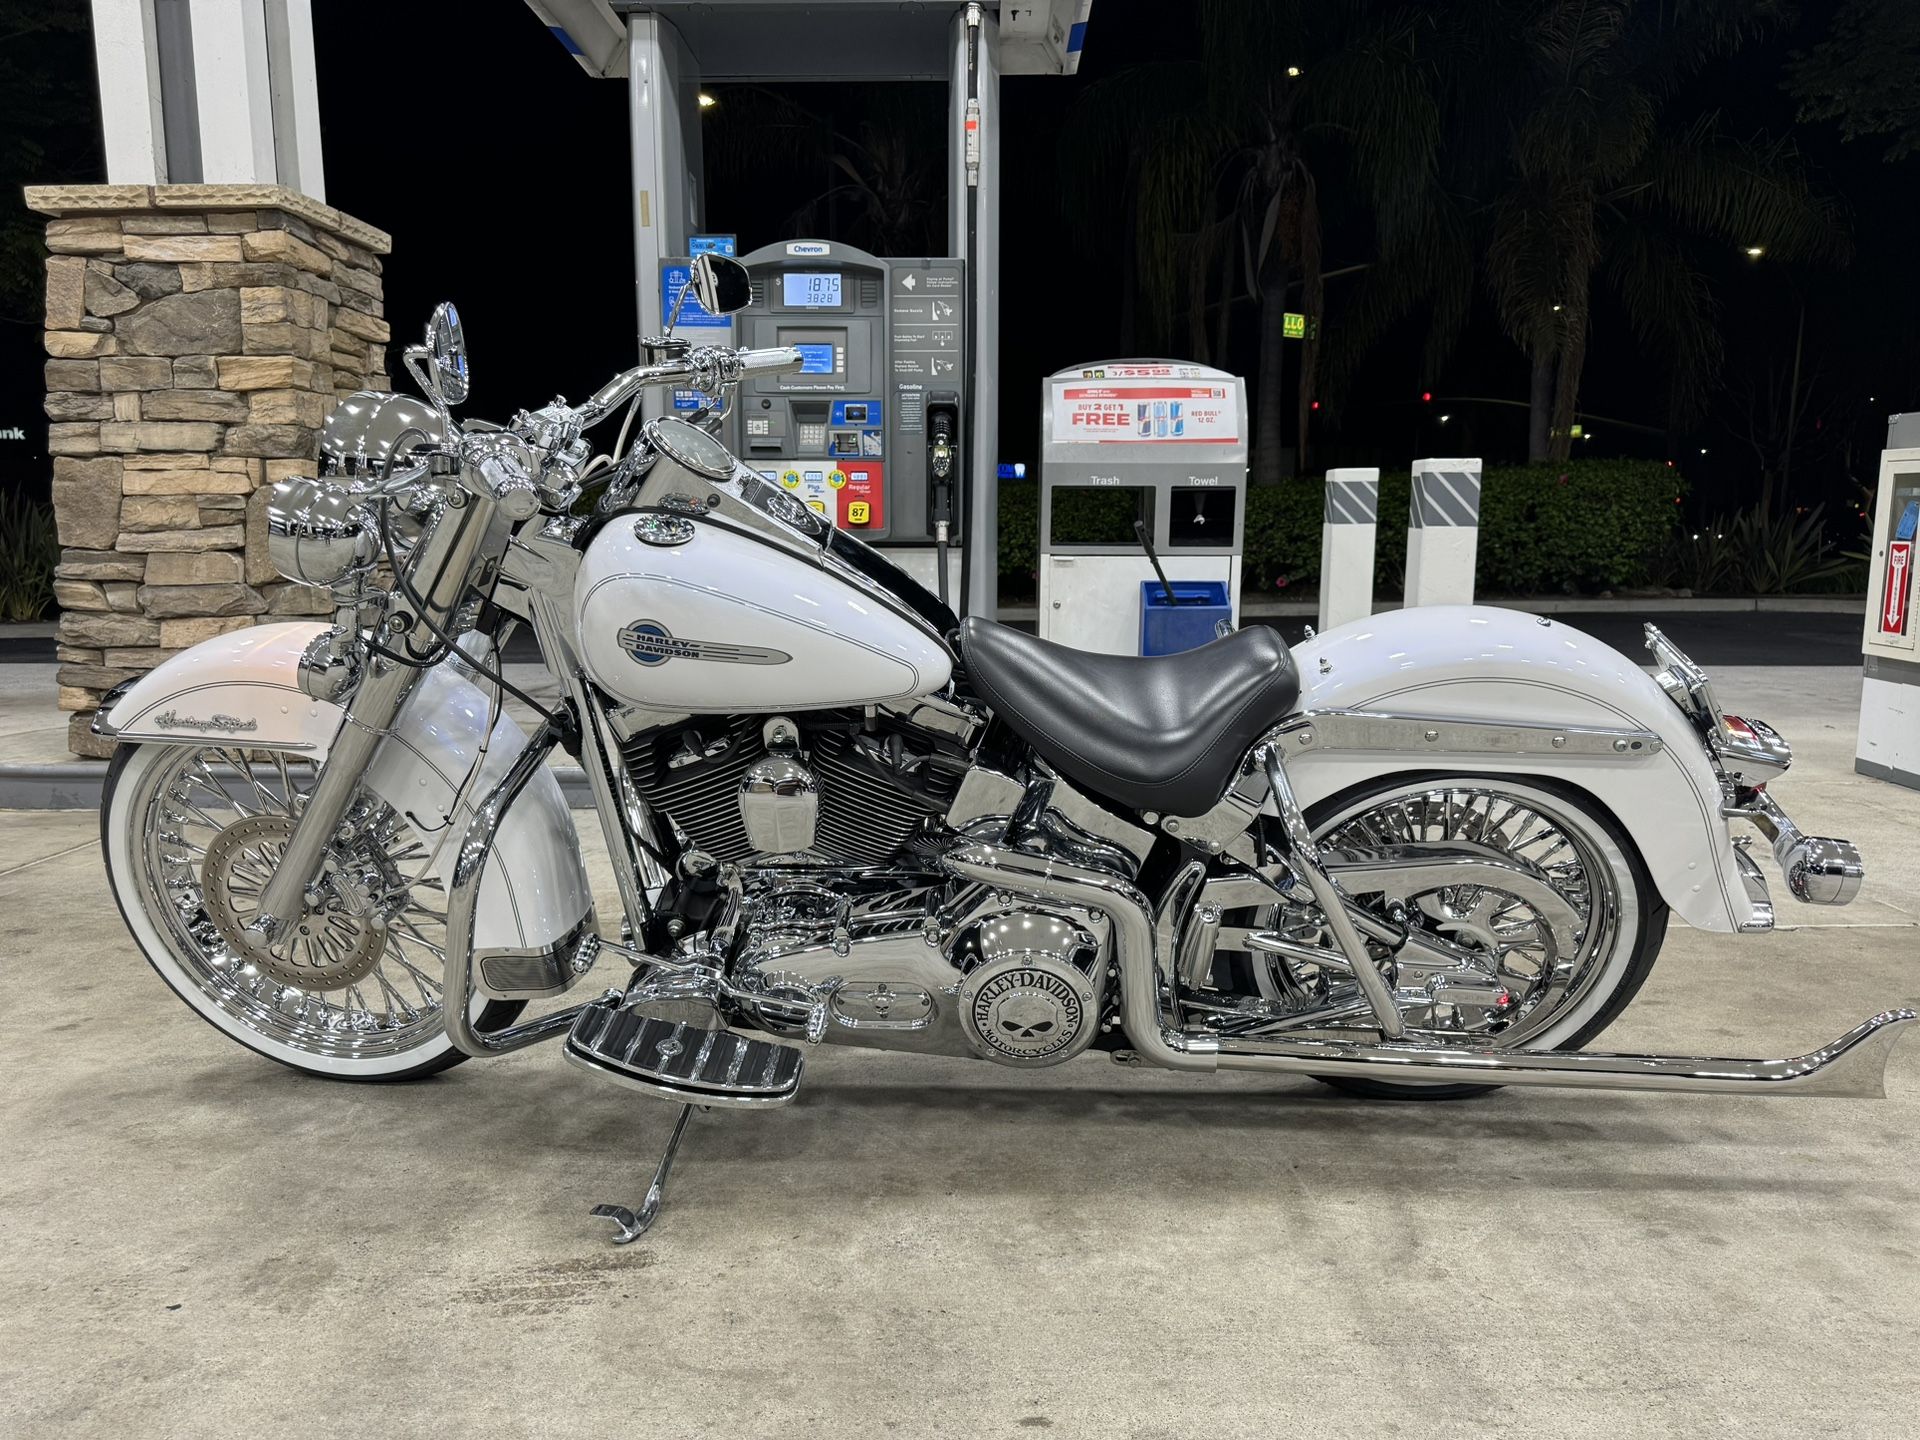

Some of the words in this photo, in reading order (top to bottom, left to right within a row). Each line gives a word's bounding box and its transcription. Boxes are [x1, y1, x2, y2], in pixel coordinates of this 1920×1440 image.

[793, 245, 823, 253] Chevron
[1284, 316, 1304, 330] LLO
[1078, 403, 1091, 411] BUY
[1094, 403, 1102, 411] 2
[1103, 403, 1116, 411] GET
[1072, 412, 1130, 426] FREE
[0, 426, 26, 440] nk
[1090, 475, 1120, 486] Trash
[1188, 475, 1218, 486] Towel
[851, 507, 865, 518] 87
[635, 643, 700, 658] DAVIDSON
[976, 972, 1080, 1025] HARLEY-DAVIDSON
[982, 1029, 1073, 1056] MOTORCYCLES
